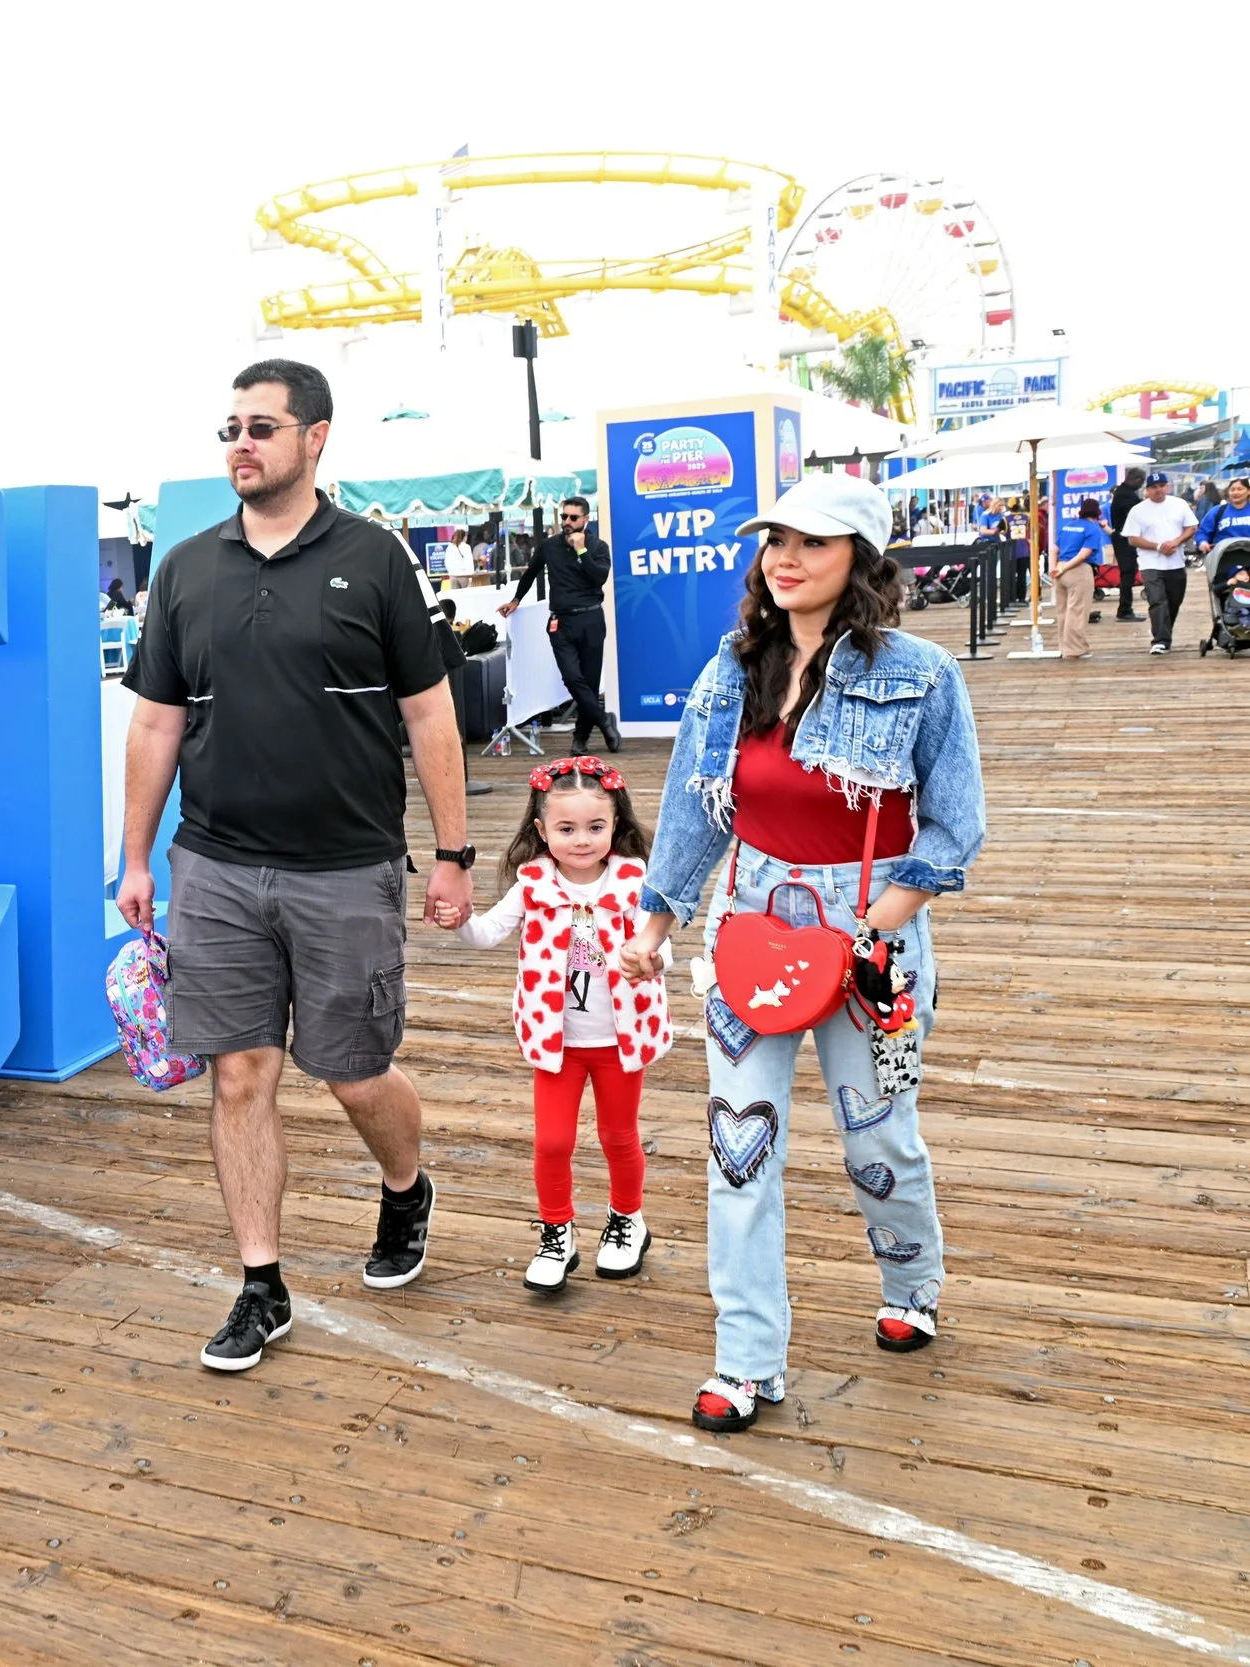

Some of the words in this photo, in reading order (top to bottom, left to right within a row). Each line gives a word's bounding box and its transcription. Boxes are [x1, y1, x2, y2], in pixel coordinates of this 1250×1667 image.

[938, 380, 986, 399] PACIFIC
[1024, 374, 1057, 393] PARK
[661, 438, 705, 451] PARTY
[672, 450, 704, 463] PIER
[653, 508, 716, 539] VIP
[629, 541, 742, 576] ENTRY
